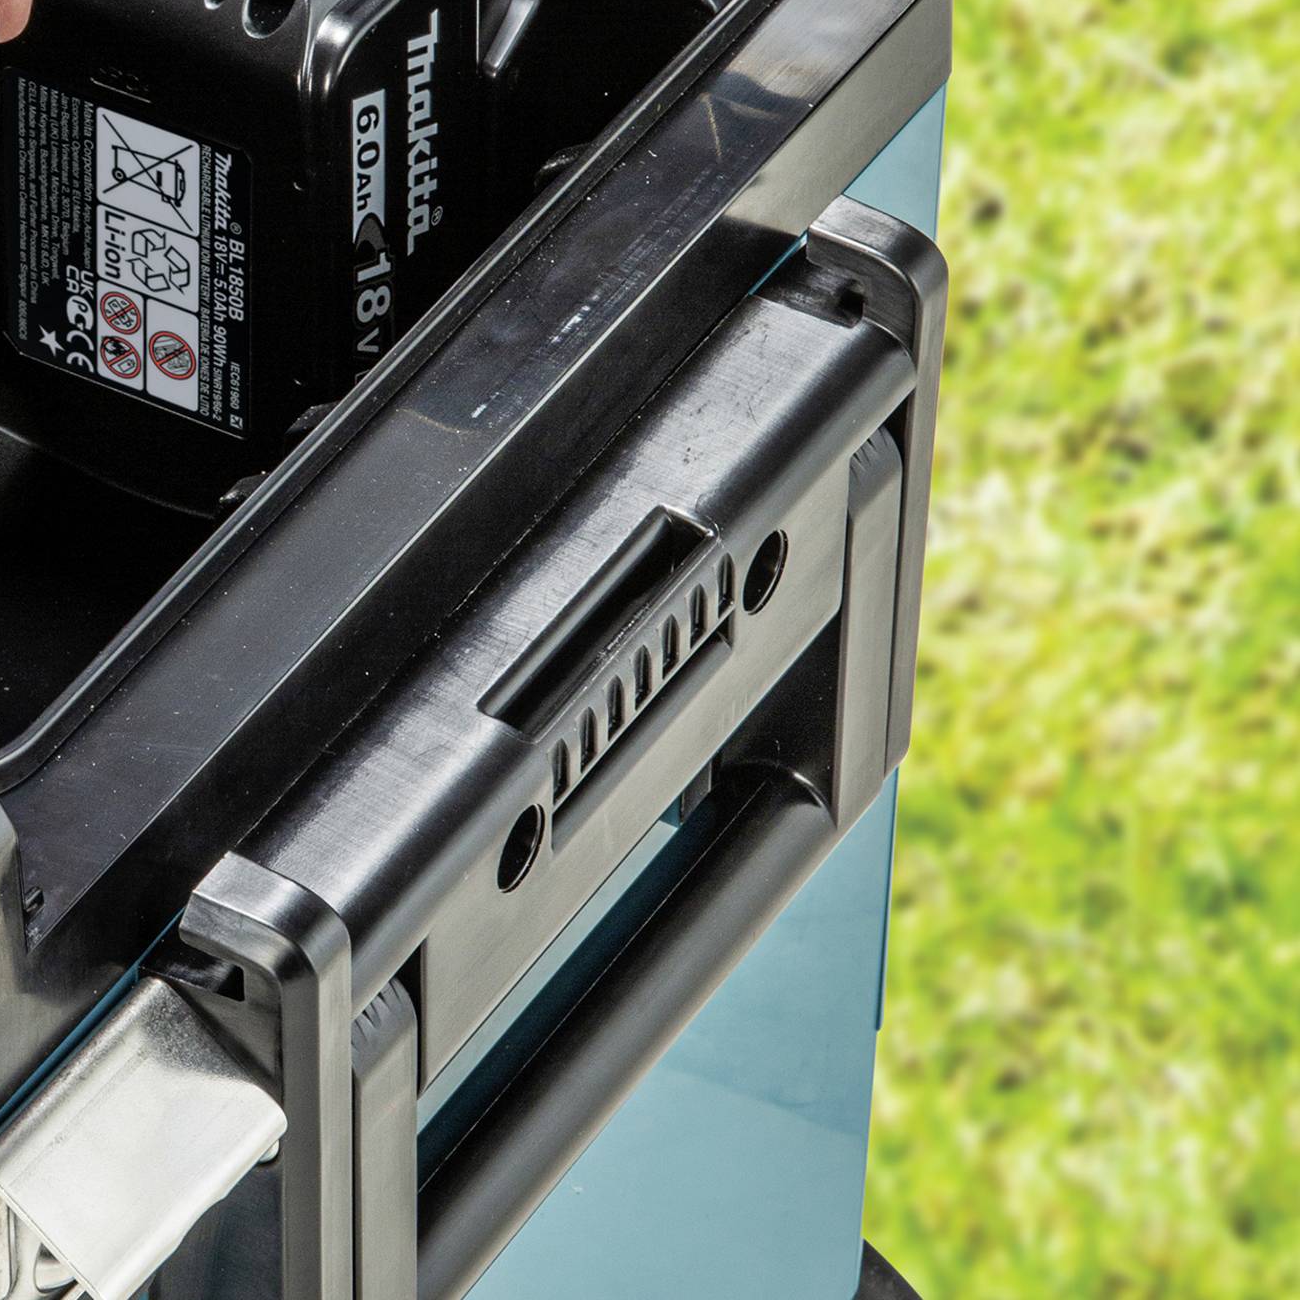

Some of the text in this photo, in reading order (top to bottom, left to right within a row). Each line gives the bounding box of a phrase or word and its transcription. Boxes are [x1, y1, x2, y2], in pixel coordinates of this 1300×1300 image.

[81, 136, 94, 203] Corporation
[199, 141, 211, 215] RECHARGEABLE
[356, 103, 381, 213] 6.0Ah
[104, 209, 125, 282] Li-ion
[199, 211, 211, 249] LITHIUM
[213, 231, 227, 263] 18V
[79, 267, 94, 300] UK
[199, 263, 211, 304] BATTERY
[212, 276, 227, 324] 5.0Ah
[228, 236, 244, 323] BL1850B
[356, 253, 392, 354] 18V
[212, 323, 227, 369] 90Wh
